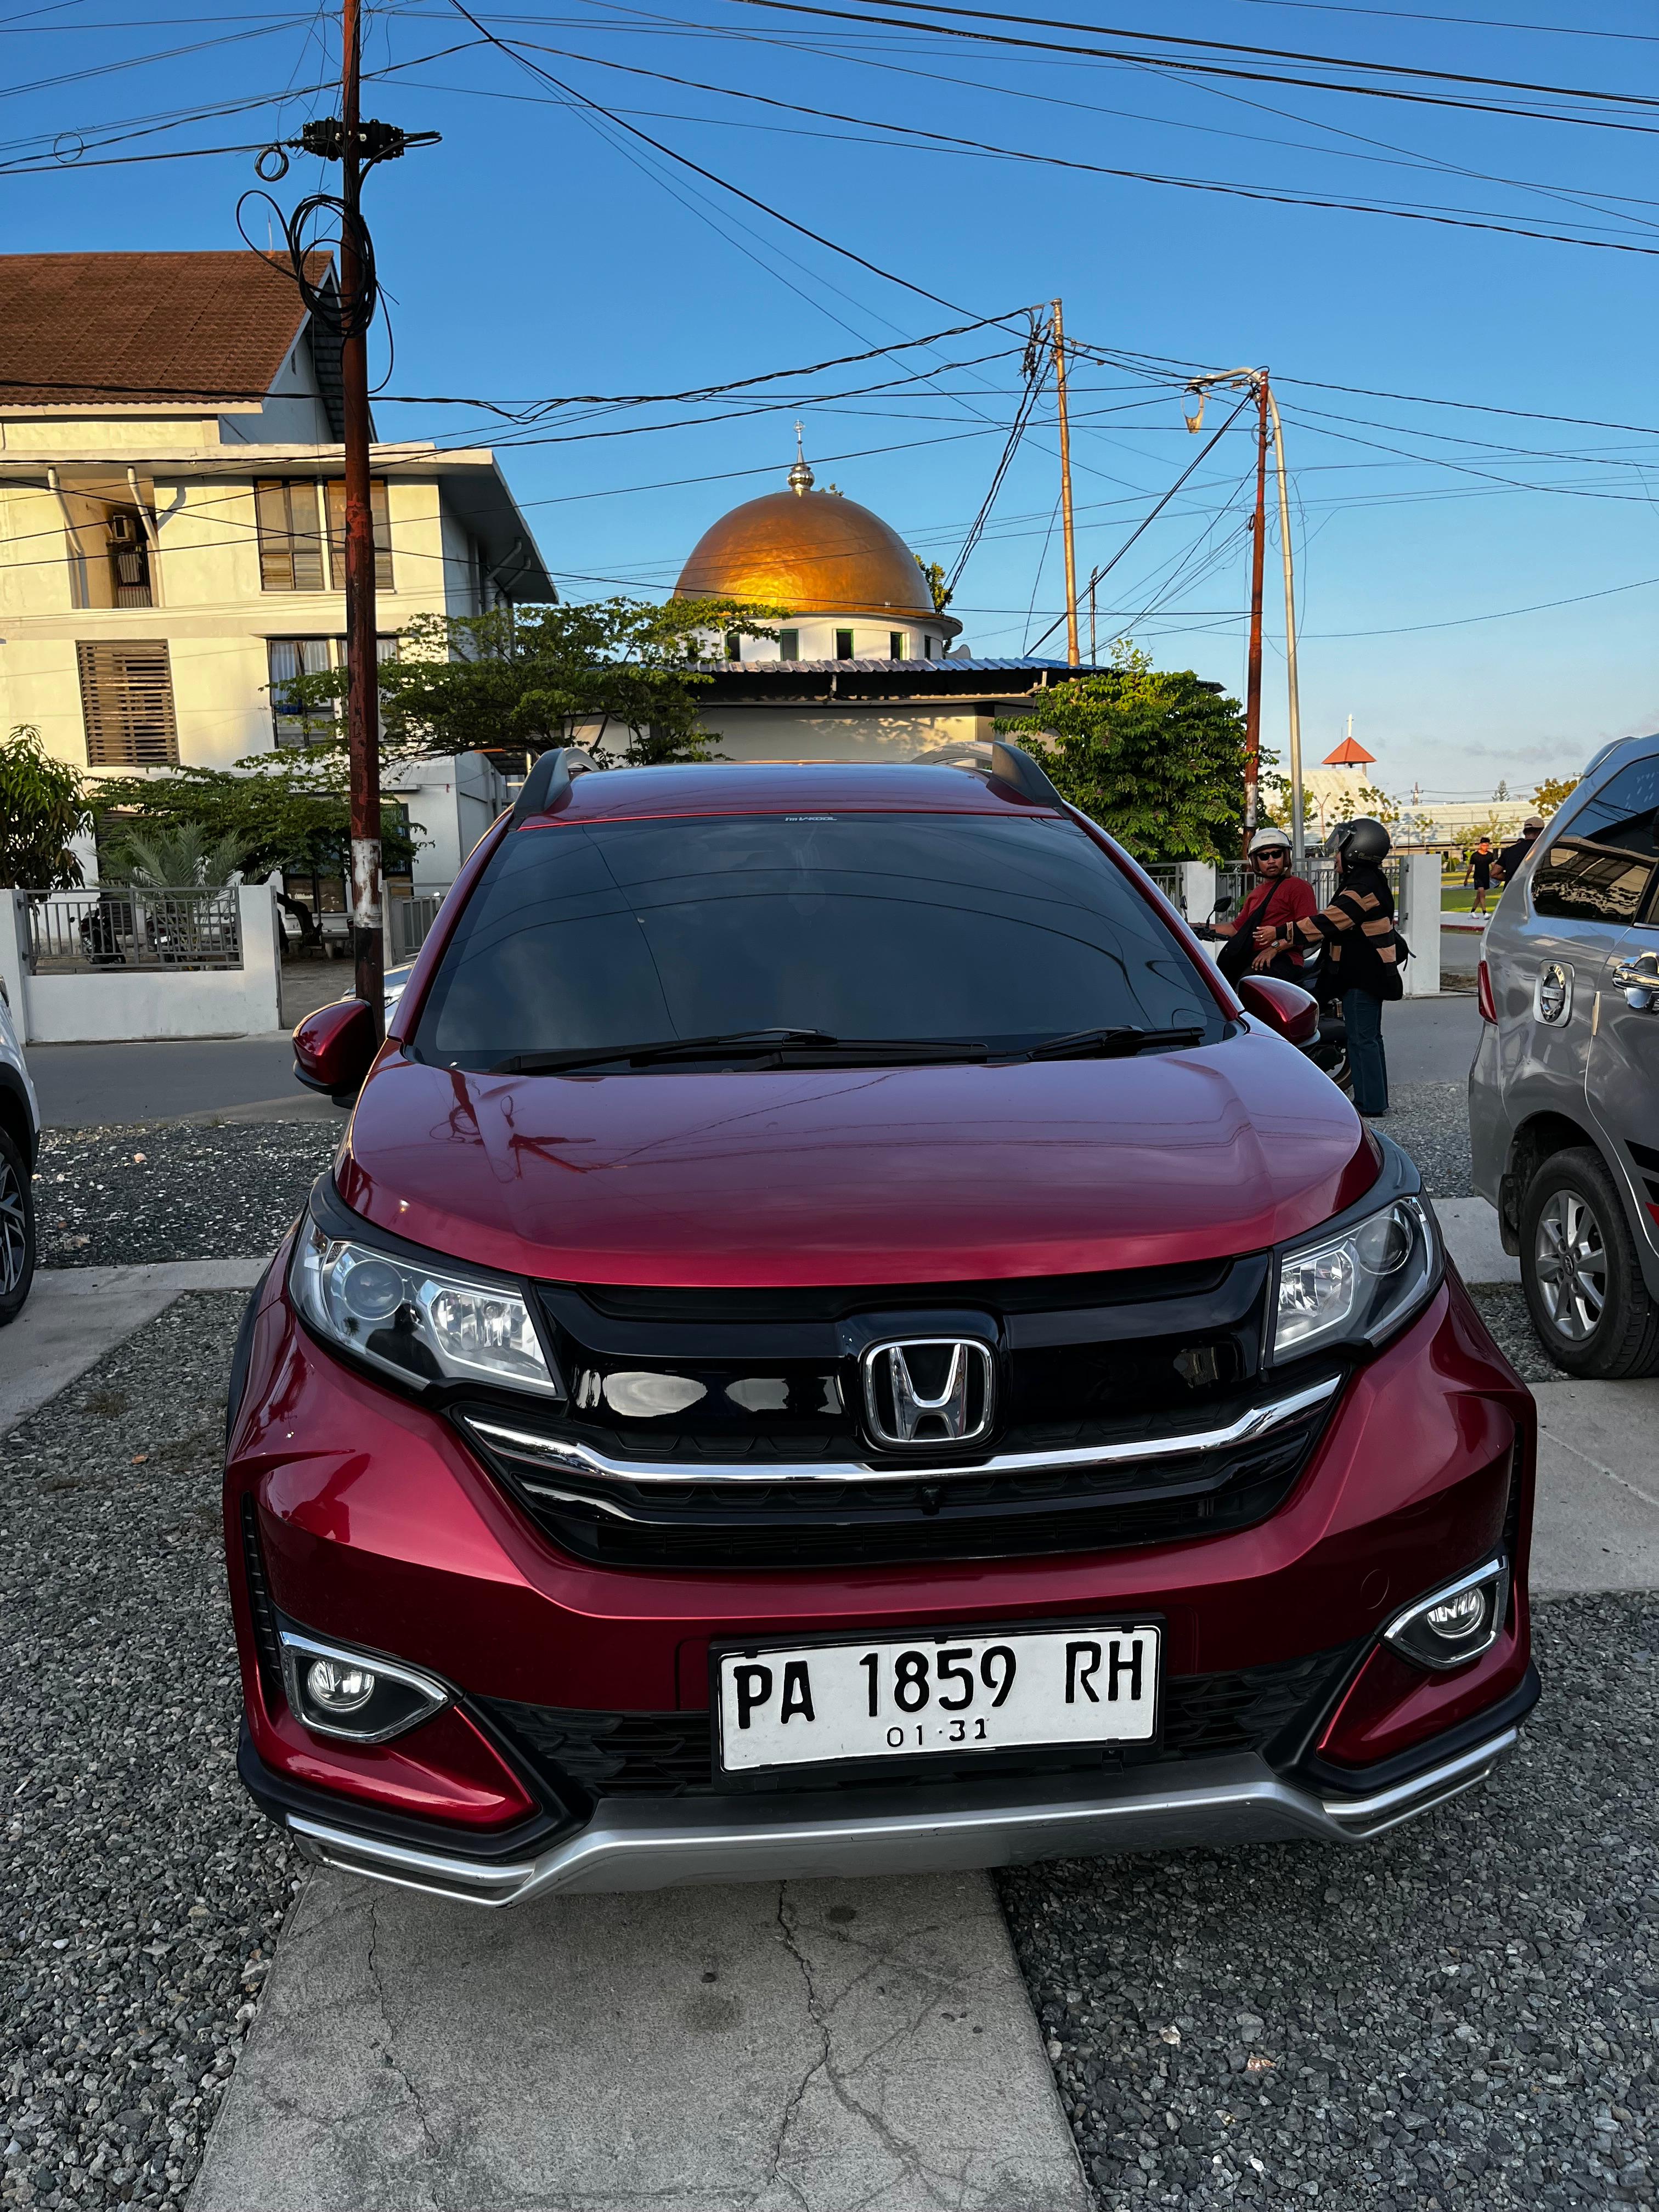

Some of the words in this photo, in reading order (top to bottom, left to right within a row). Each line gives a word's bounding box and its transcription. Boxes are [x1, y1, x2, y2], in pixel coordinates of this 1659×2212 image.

[733, 1660, 815, 1730] PA
[859, 1645, 1017, 1717] 1859
[1065, 1640, 1143, 1703] RH
